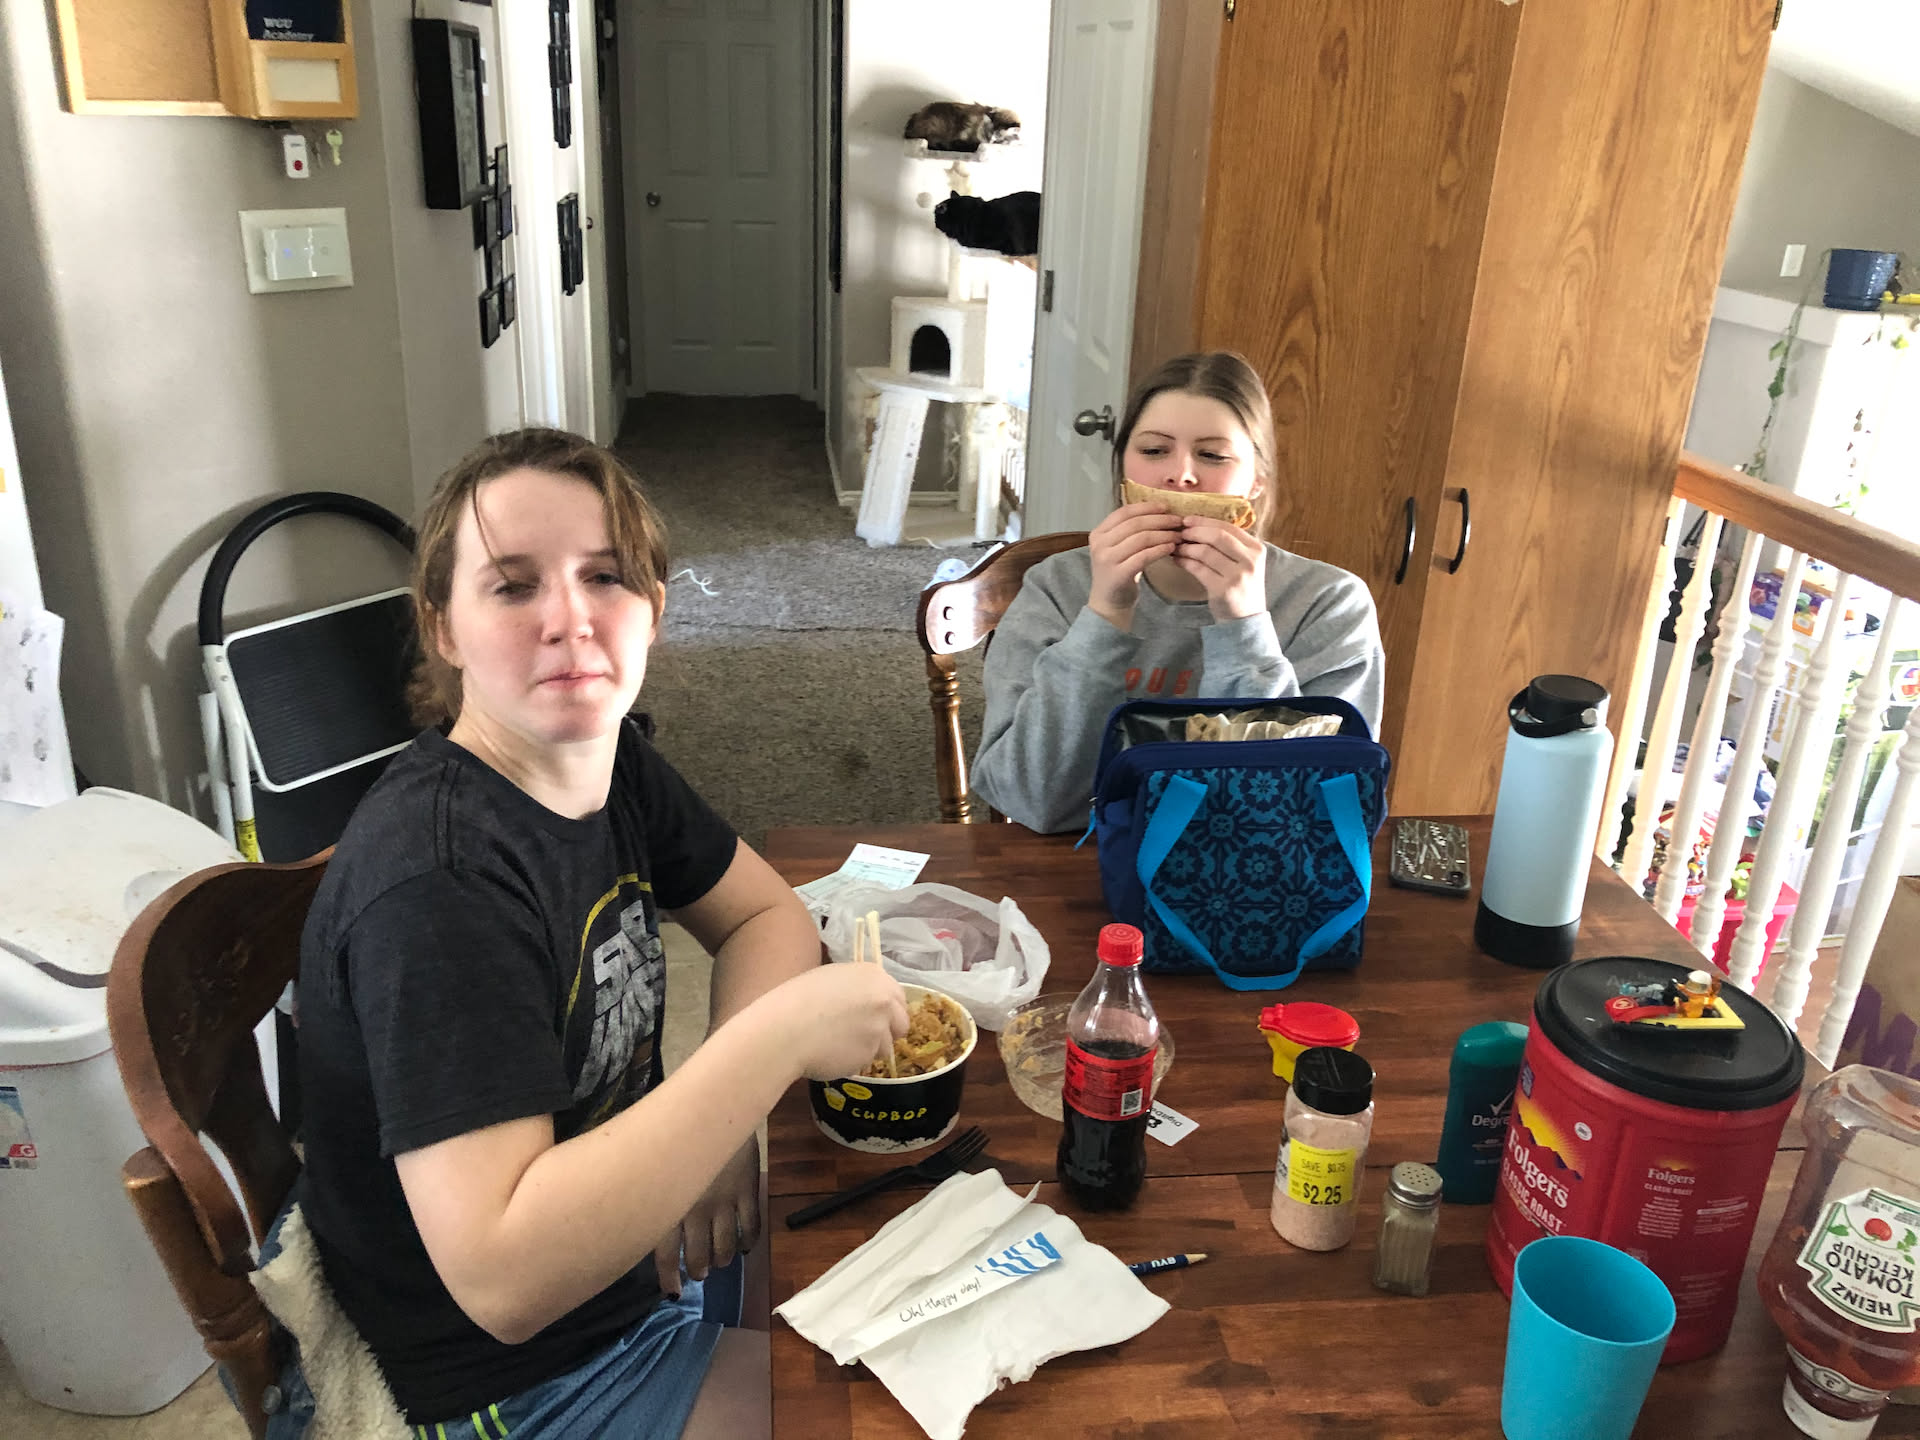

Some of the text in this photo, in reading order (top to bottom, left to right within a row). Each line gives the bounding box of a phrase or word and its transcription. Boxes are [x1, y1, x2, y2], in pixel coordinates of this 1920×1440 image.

[851, 1107, 927, 1121] CUPBOP
[1301, 1158, 1321, 1173] SAVE
[1508, 1127, 1569, 1209] Folgers
[1647, 1167, 1696, 1185] Folgers
[1303, 1182, 1342, 1205] $2.25
[1503, 1157, 1530, 1204] CLASSIC
[1530, 1197, 1563, 1233] ROAST
[1151, 1256, 1177, 1269] BYU
[1832, 1241, 1914, 1282] KETCHUP
[1825, 1251, 1914, 1299] TOMATO
[924, 1292, 958, 1310] Happy
[1831, 1281, 1893, 1316] HEINZ
